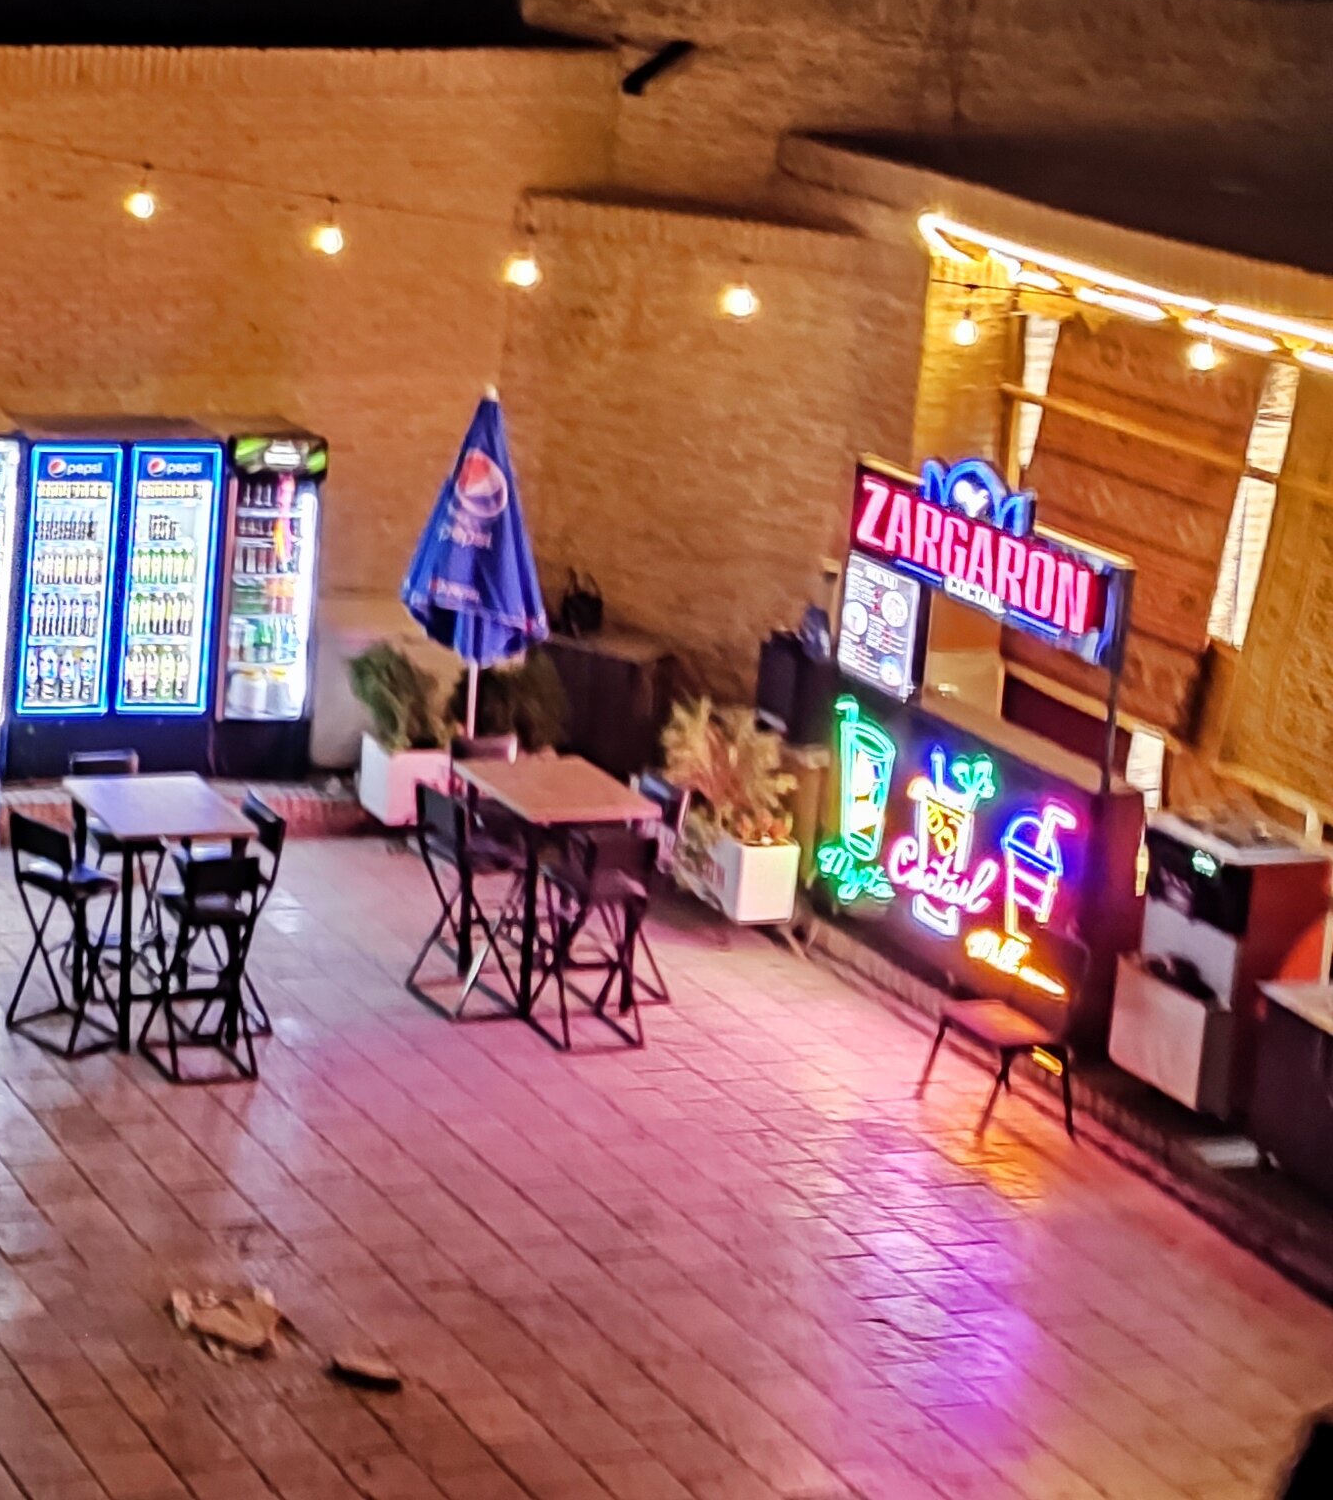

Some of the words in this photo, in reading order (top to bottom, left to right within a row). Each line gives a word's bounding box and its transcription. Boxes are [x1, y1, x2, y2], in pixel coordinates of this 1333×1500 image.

[66, 461, 104, 476] pepsi
[166, 461, 203, 476] pepsi
[856, 474, 1091, 637] ZARGARON
